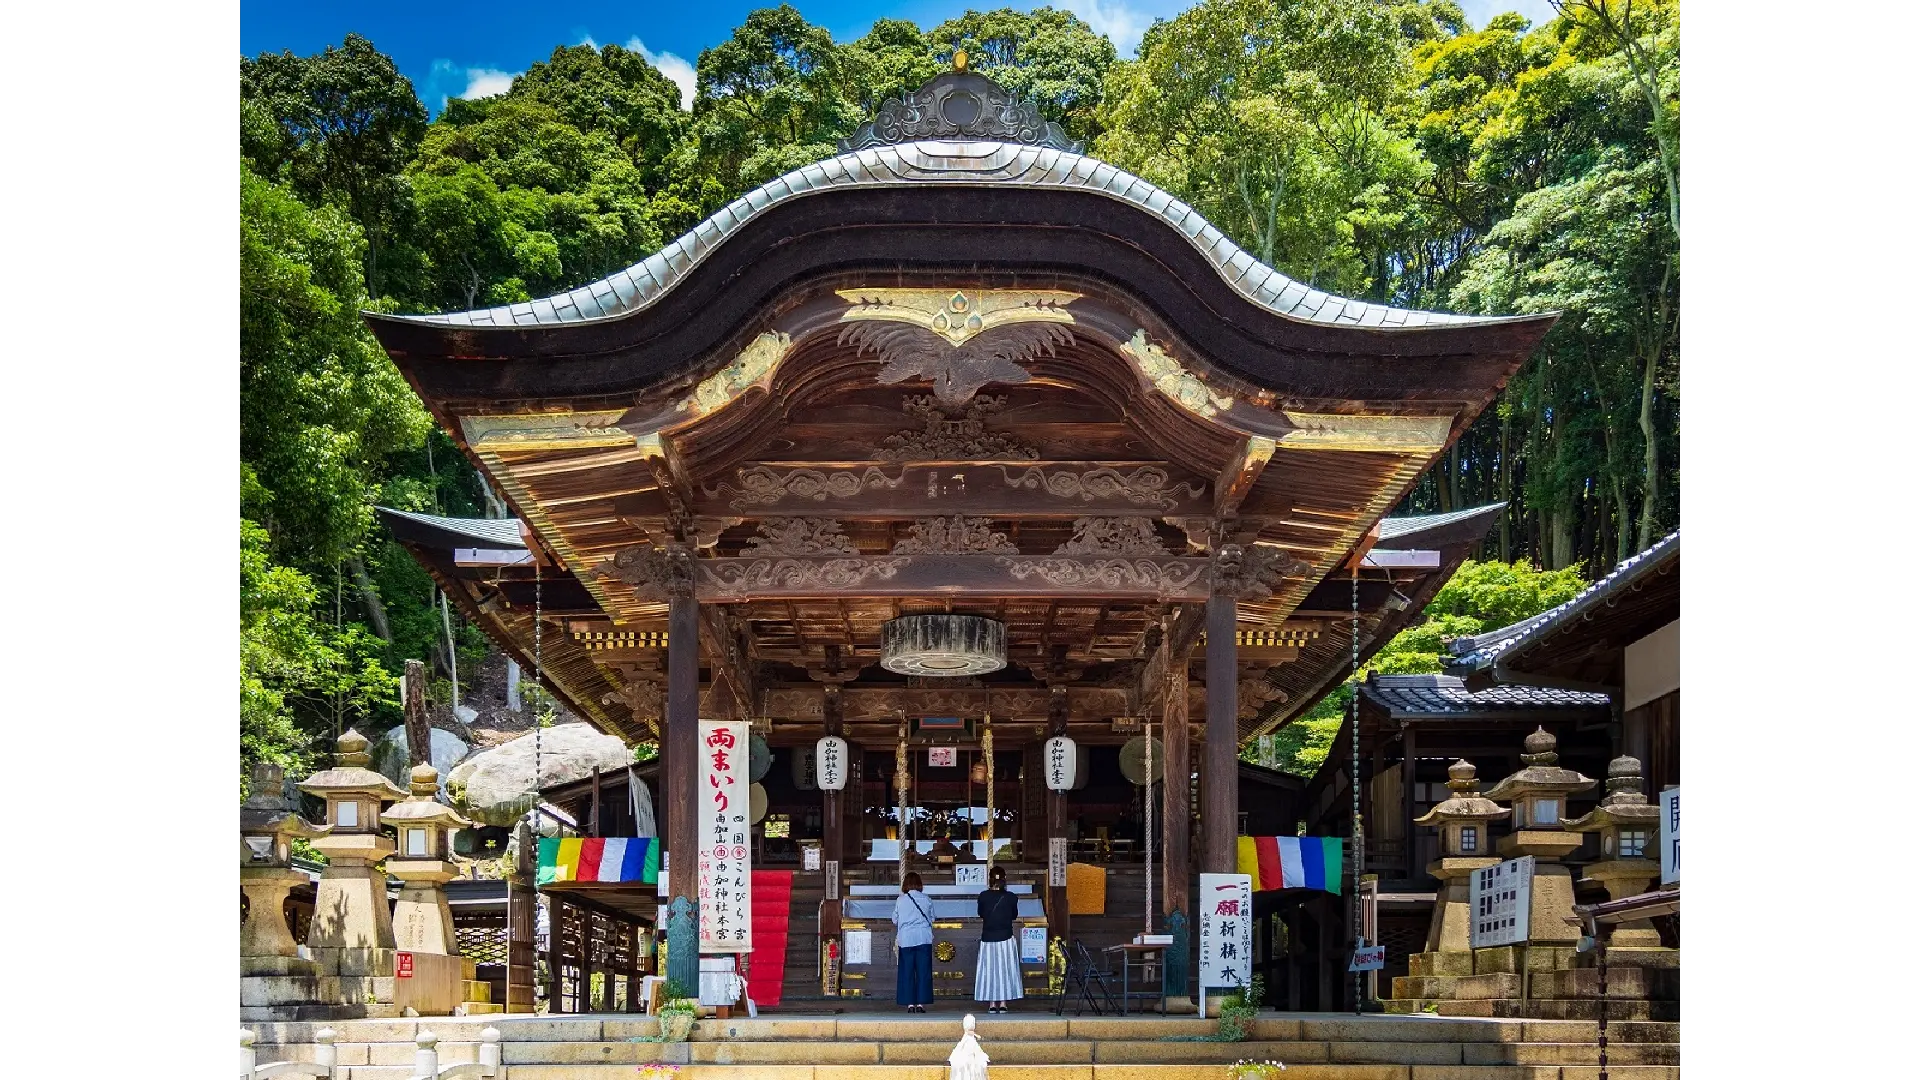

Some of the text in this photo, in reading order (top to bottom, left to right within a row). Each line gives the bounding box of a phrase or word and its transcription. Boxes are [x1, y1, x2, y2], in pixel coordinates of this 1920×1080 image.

[706, 727, 735, 812] 両まいり
[825, 740, 838, 785] 由加神社本宮
[1051, 740, 1064, 785] 由加神社本宮
